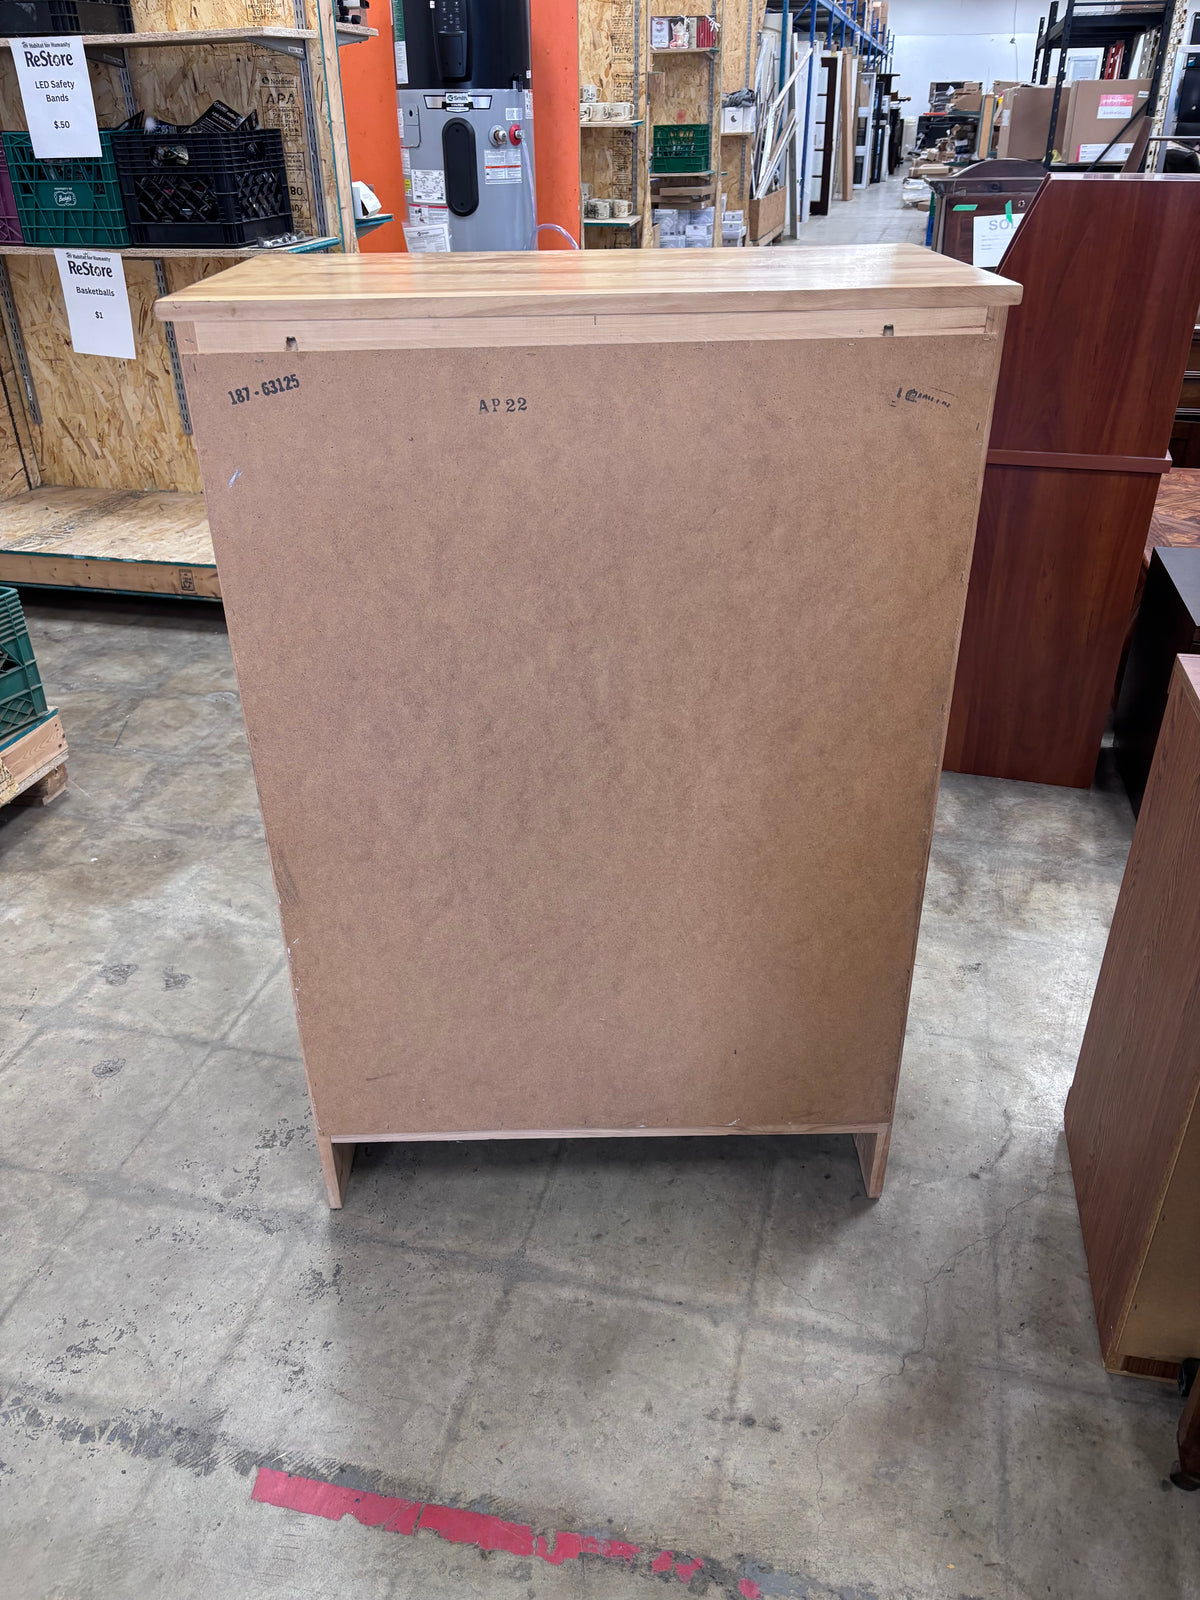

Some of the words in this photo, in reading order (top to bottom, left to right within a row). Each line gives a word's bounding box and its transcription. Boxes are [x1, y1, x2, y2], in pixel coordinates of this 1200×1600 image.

[24, 50, 74, 67] ReStore
[34, 80, 49, 89] LED
[51, 80, 75, 90] Safety
[46, 94, 69, 102] Bands
[266, 93, 295, 104] APA
[53, 120, 70, 129] $.50
[67, 260, 113, 278] ReStore
[76, 286, 115, 297] Basketballs
[95, 311, 104, 319] $1
